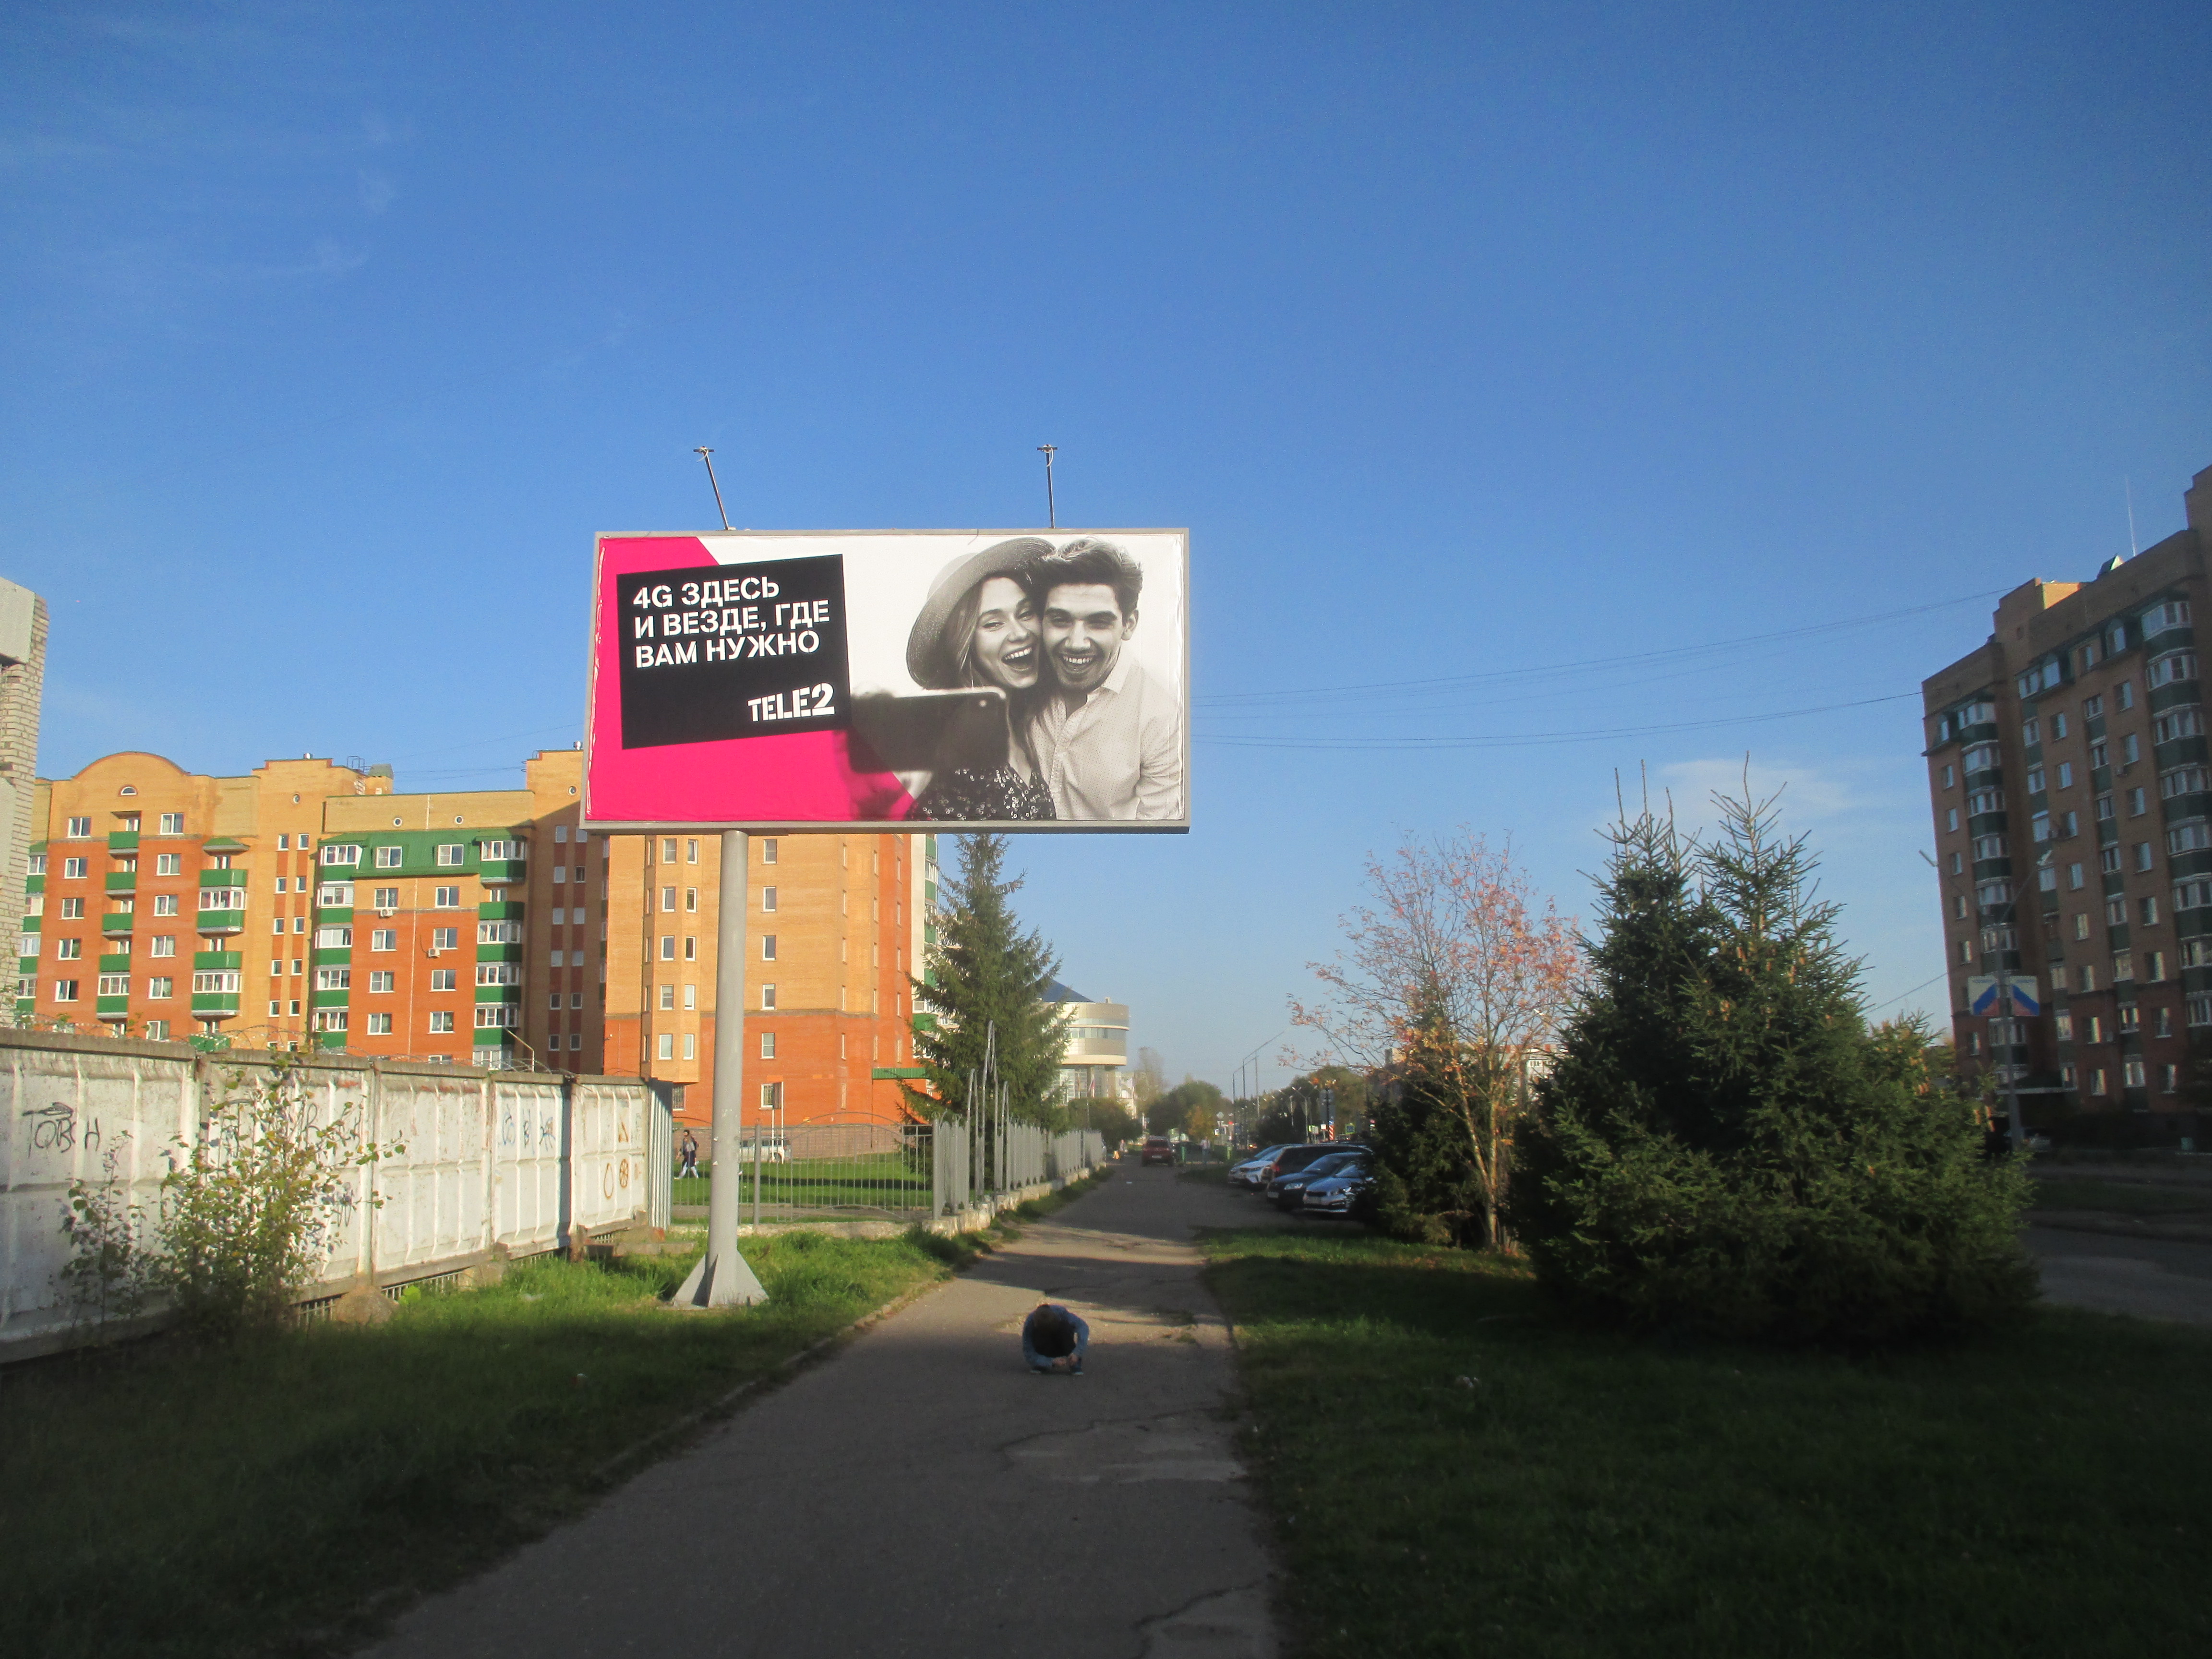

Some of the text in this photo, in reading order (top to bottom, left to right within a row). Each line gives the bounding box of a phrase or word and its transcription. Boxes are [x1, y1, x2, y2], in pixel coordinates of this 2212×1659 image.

[634, 577, 780, 610] 4G ЗДЕСЬ
[635, 600, 830, 639] И ВЕЗДЕ, ГДЕ
[636, 630, 820, 669] ВАМ НУЖНО
[748, 683, 836, 722] TELE2
